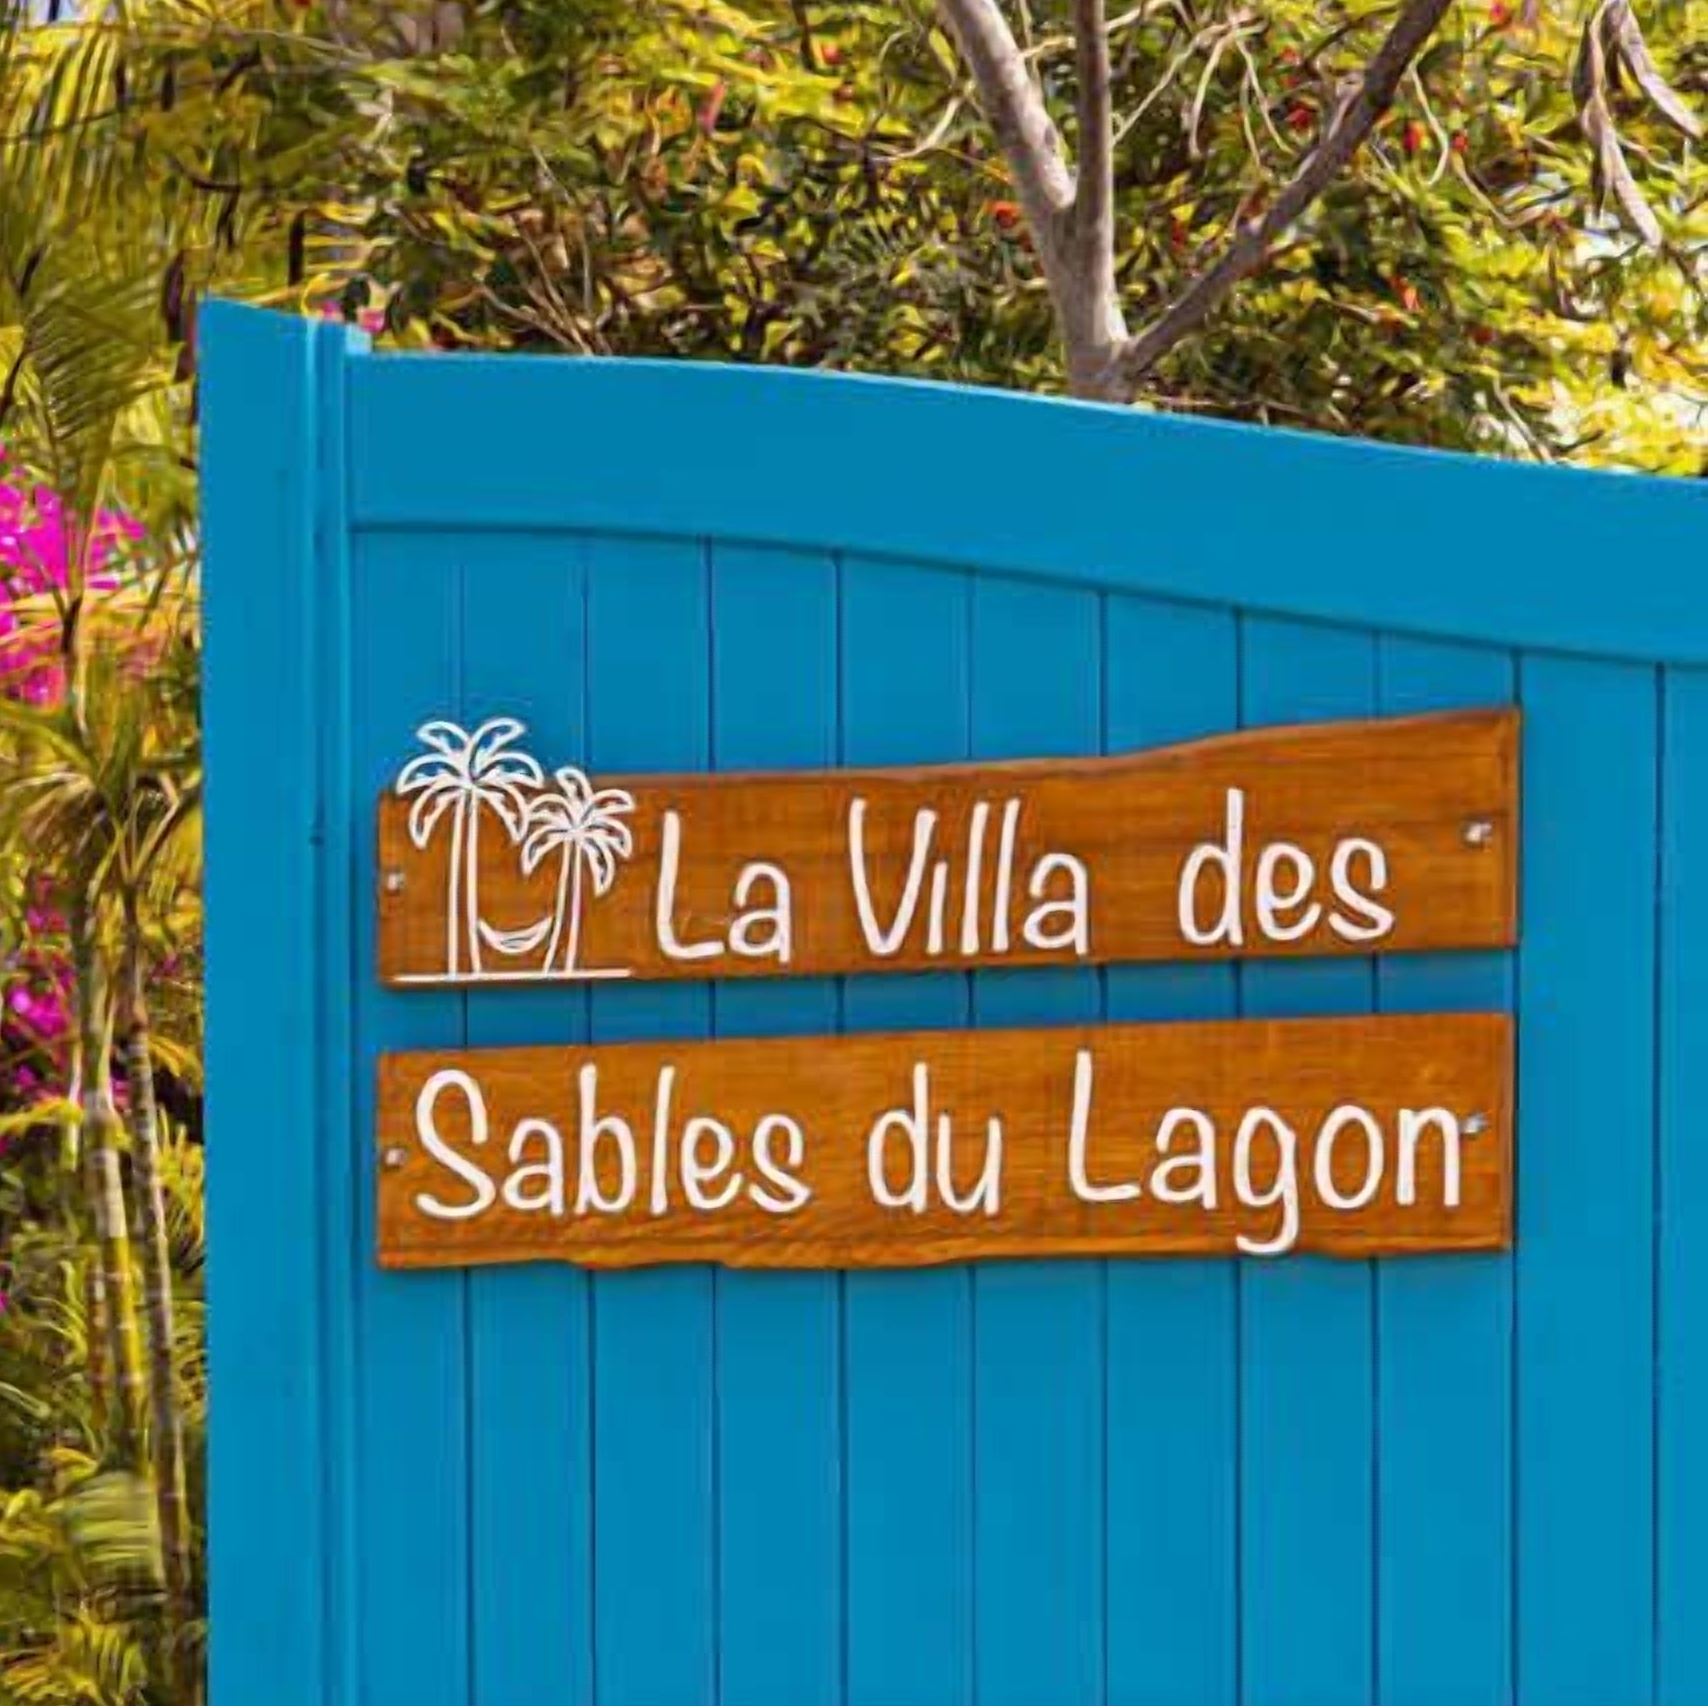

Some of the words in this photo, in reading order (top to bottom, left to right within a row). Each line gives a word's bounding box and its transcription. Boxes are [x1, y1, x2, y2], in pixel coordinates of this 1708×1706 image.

[655, 810, 792, 963] La
[846, 796, 1090, 956] Villa
[1177, 787, 1395, 947] des
[414, 1063, 812, 1220] Sables
[865, 1062, 1003, 1215] du
[1067, 1049, 1462, 1256] Lagon
